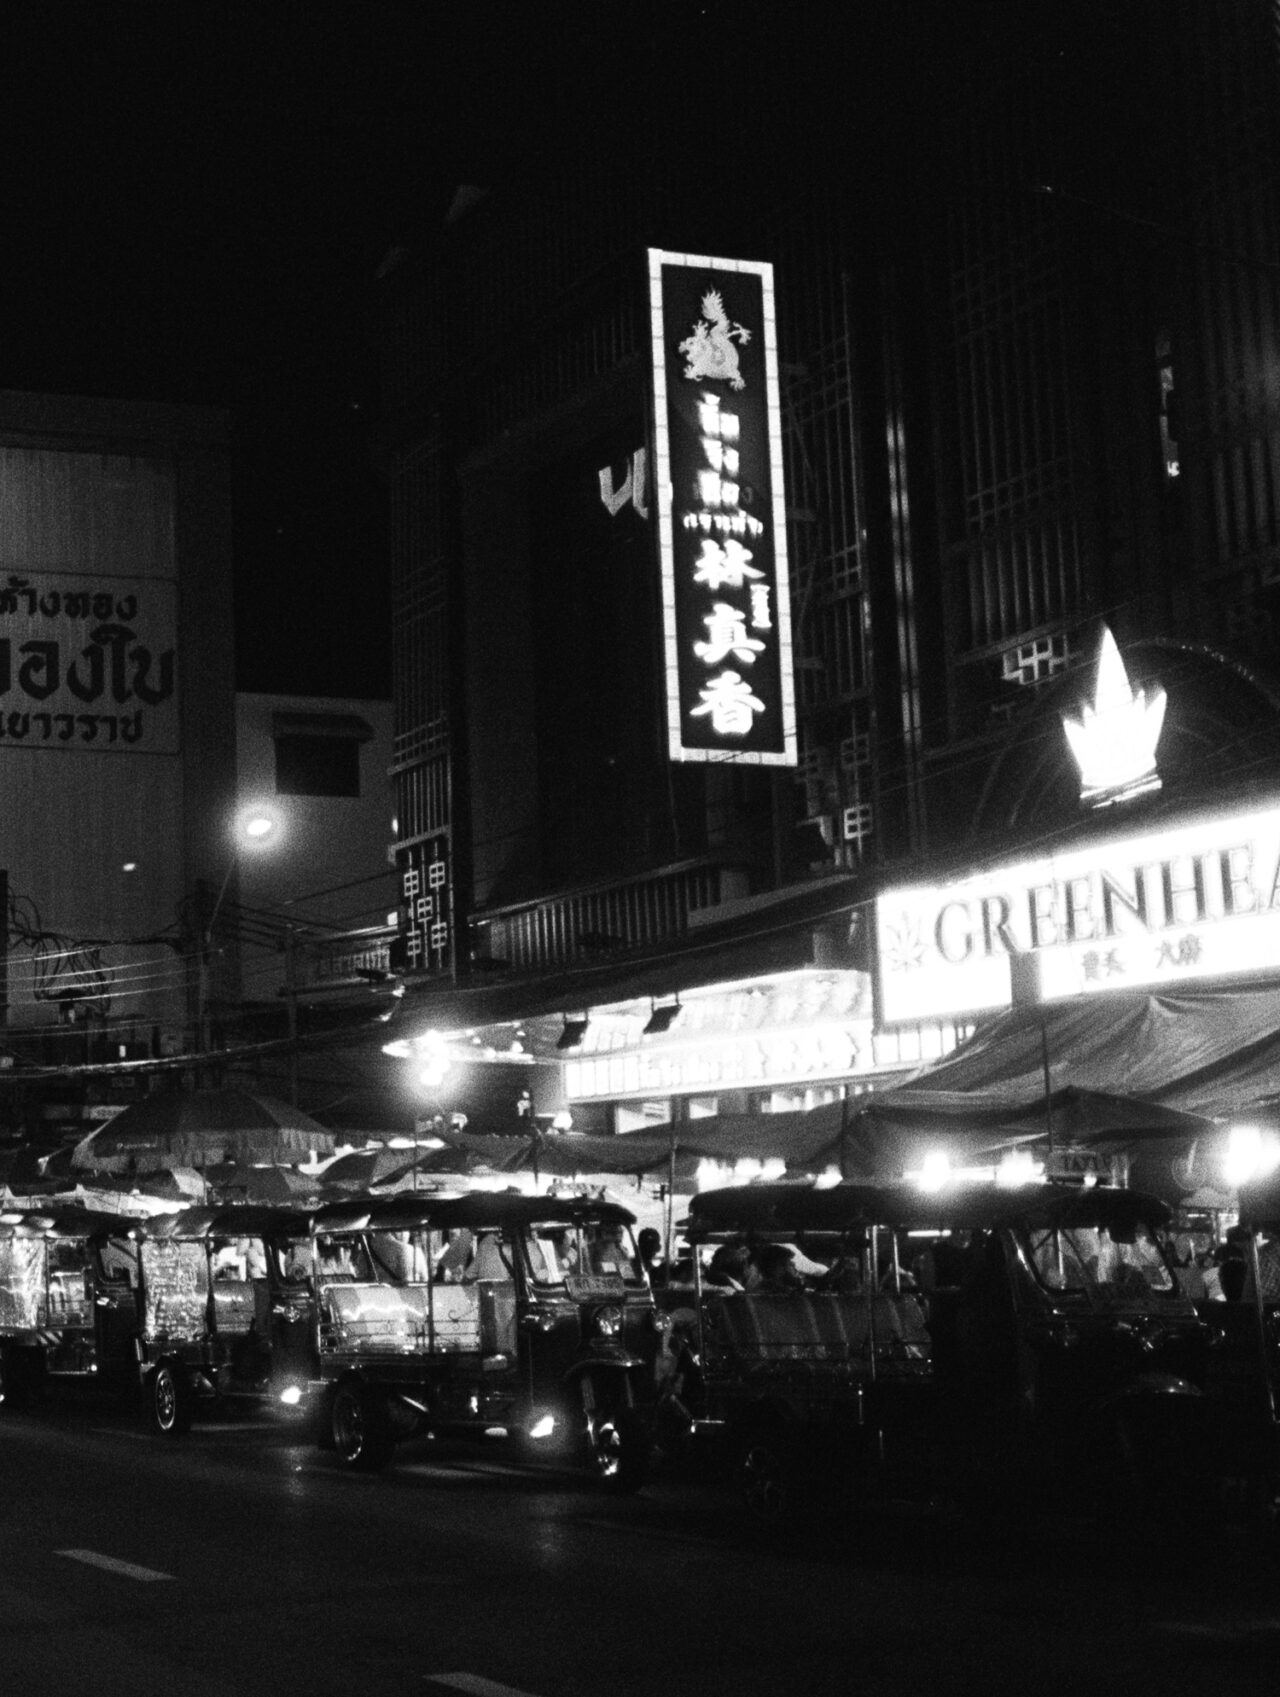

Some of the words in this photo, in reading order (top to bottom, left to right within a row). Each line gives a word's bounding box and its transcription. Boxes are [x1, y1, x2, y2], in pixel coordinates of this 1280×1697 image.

[690, 539, 767, 735] 林真香
[934, 842, 1280, 965] GREENHE
